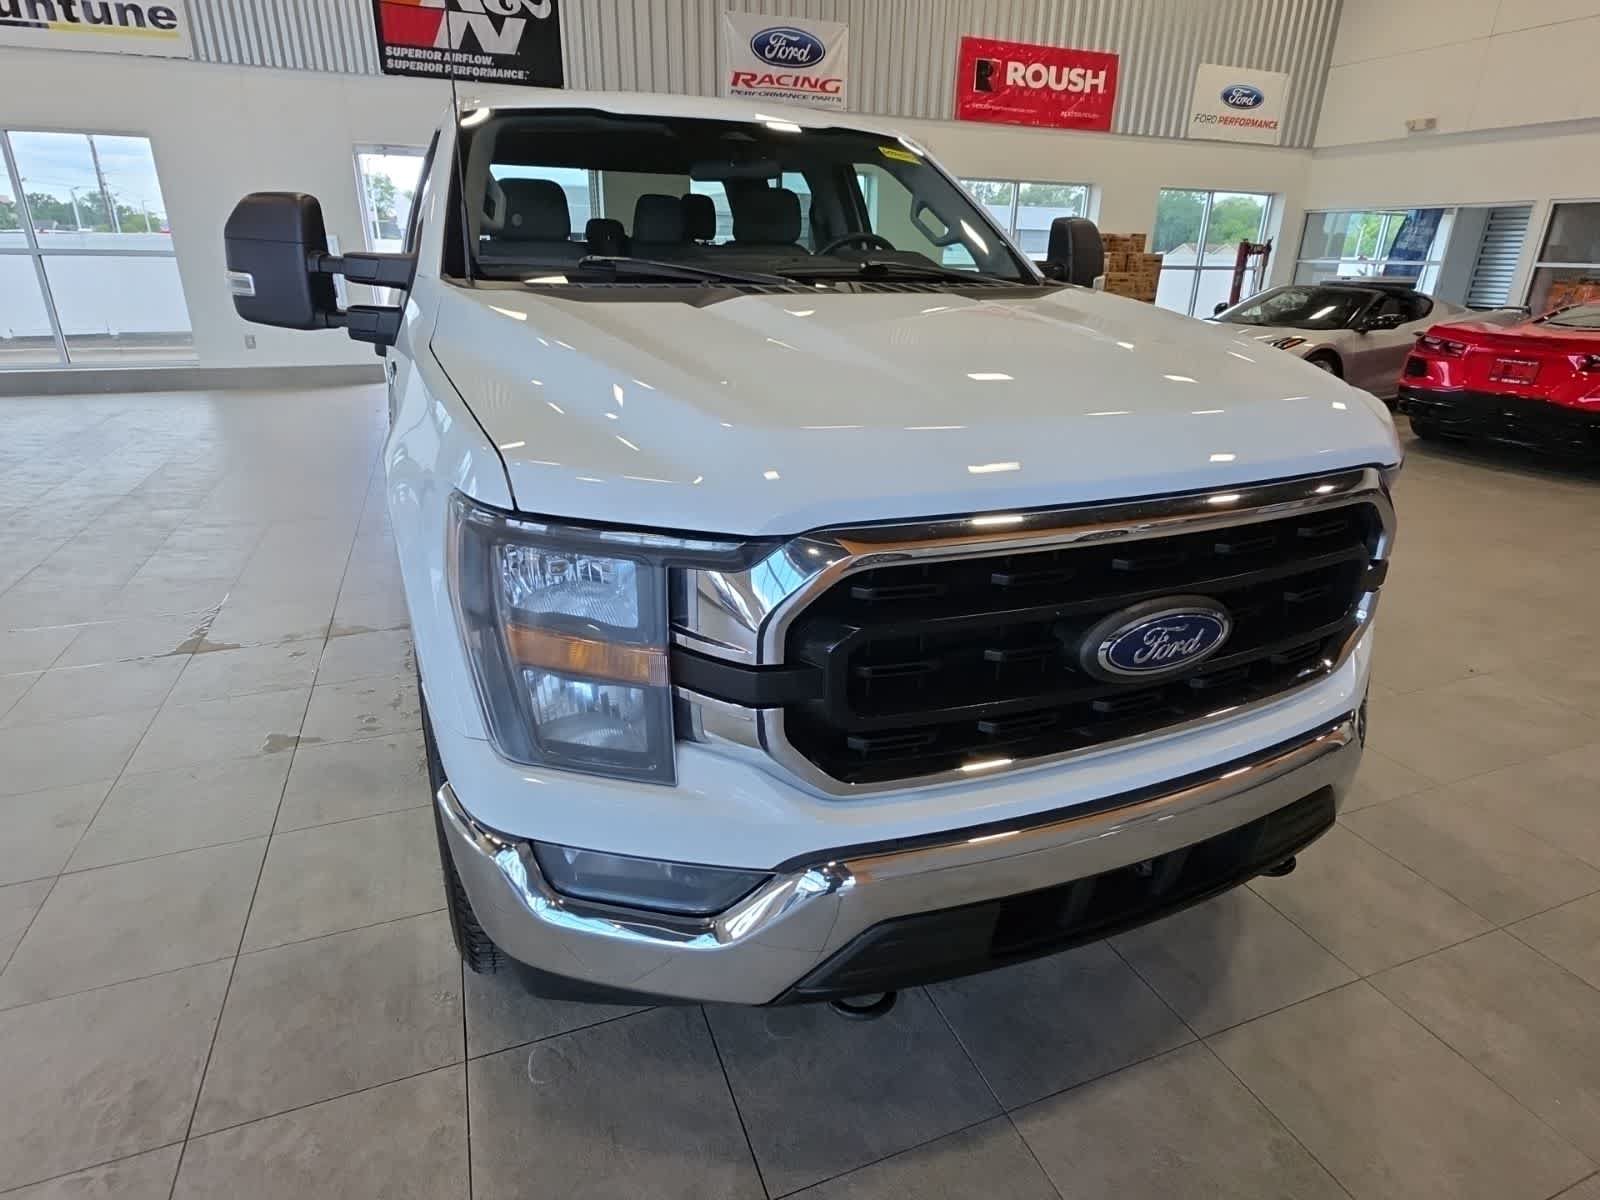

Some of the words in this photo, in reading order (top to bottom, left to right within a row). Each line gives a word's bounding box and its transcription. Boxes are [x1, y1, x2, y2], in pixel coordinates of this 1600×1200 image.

[385, 46, 442, 60] SUPERIOR
[443, 52, 495, 66] AIRFLOW.
[764, 32, 812, 61] Ford
[386, 58, 443, 73] SUPERIOR
[731, 71, 842, 93] RACING
[1006, 61, 1106, 94] ROUSH
[730, 89, 810, 100] PERFORMANCE
[811, 95, 842, 103] PARTS
[1228, 88, 1257, 106] Ford
[1193, 113, 1217, 125] FORD
[1217, 115, 1280, 130] PERFORMANCE
[1133, 623, 1205, 665] Ford
